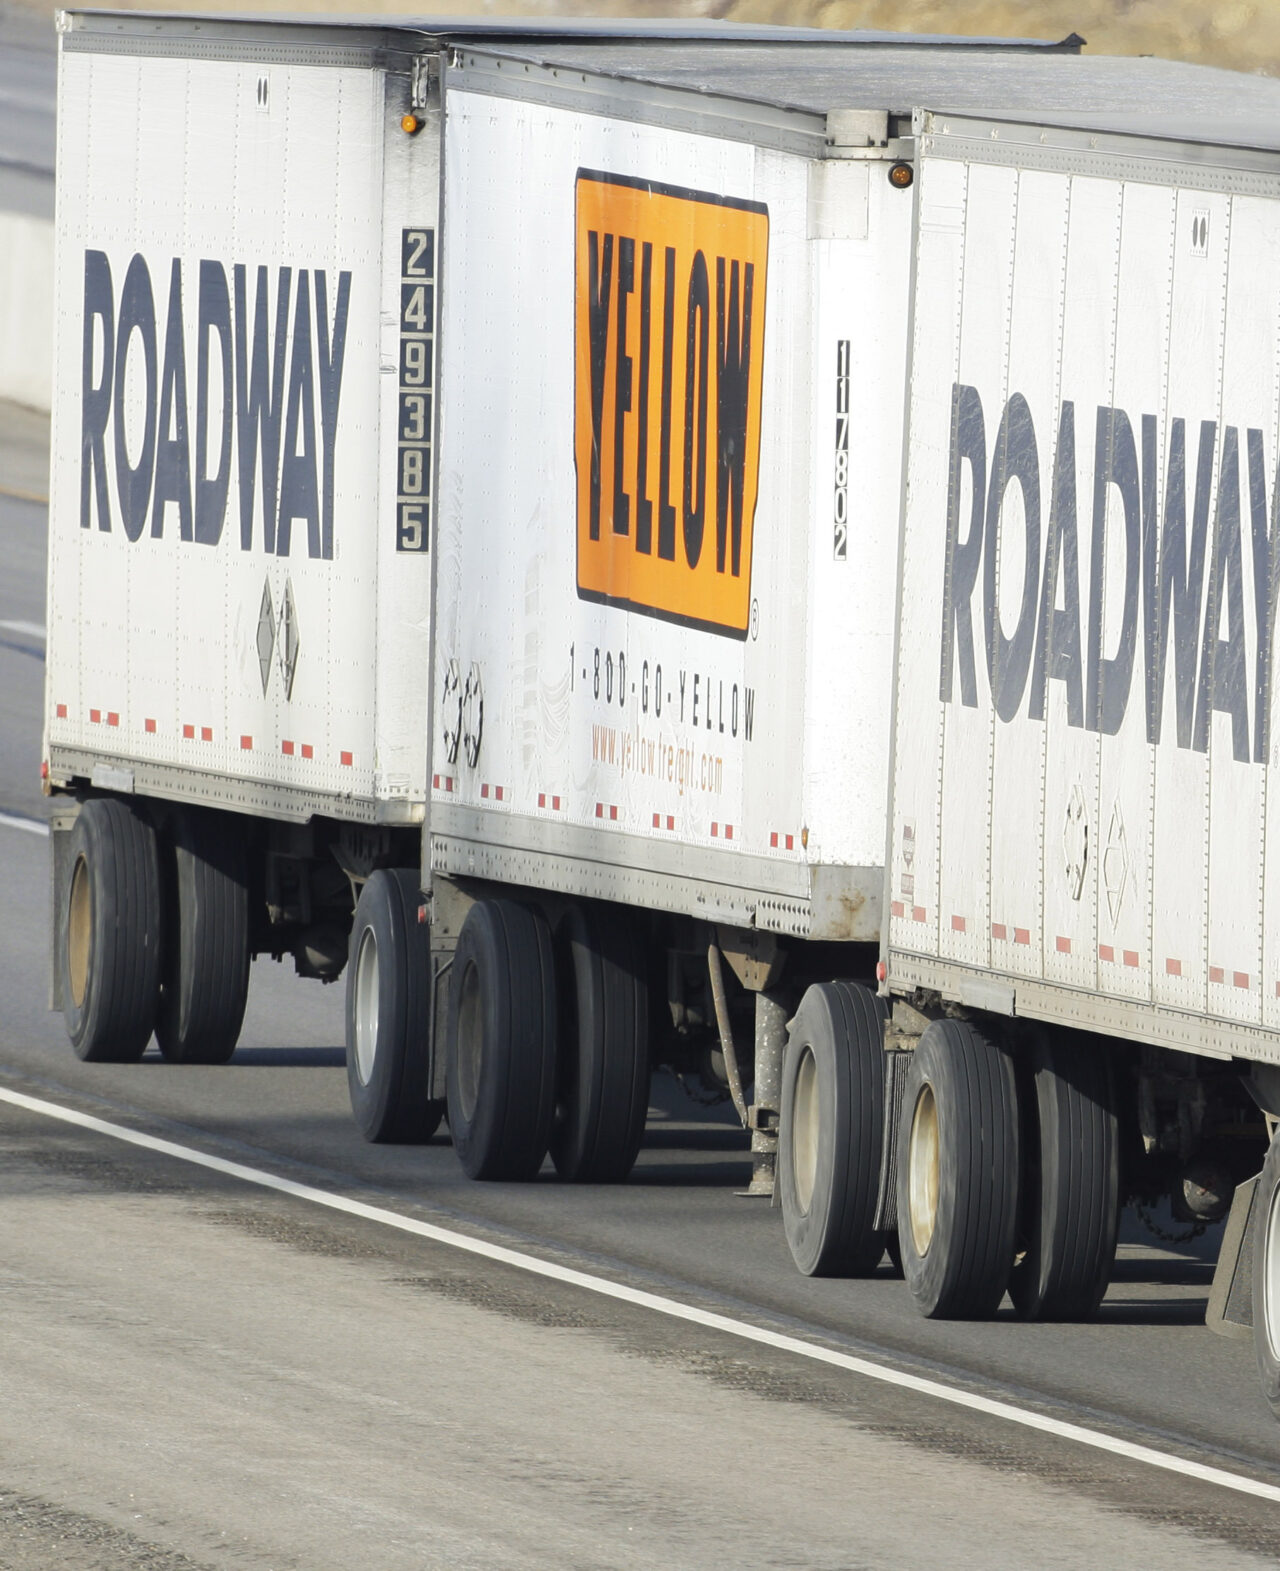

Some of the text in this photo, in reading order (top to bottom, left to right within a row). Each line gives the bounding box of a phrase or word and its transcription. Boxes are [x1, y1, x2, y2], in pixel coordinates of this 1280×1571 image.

[80, 249, 352, 561] ROADWAY
[399, 230, 431, 551] 249385
[588, 230, 754, 578] YELLOW
[834, 340, 850, 561] 117802
[570, 641, 755, 742] 1-800-GO-YELLOW
